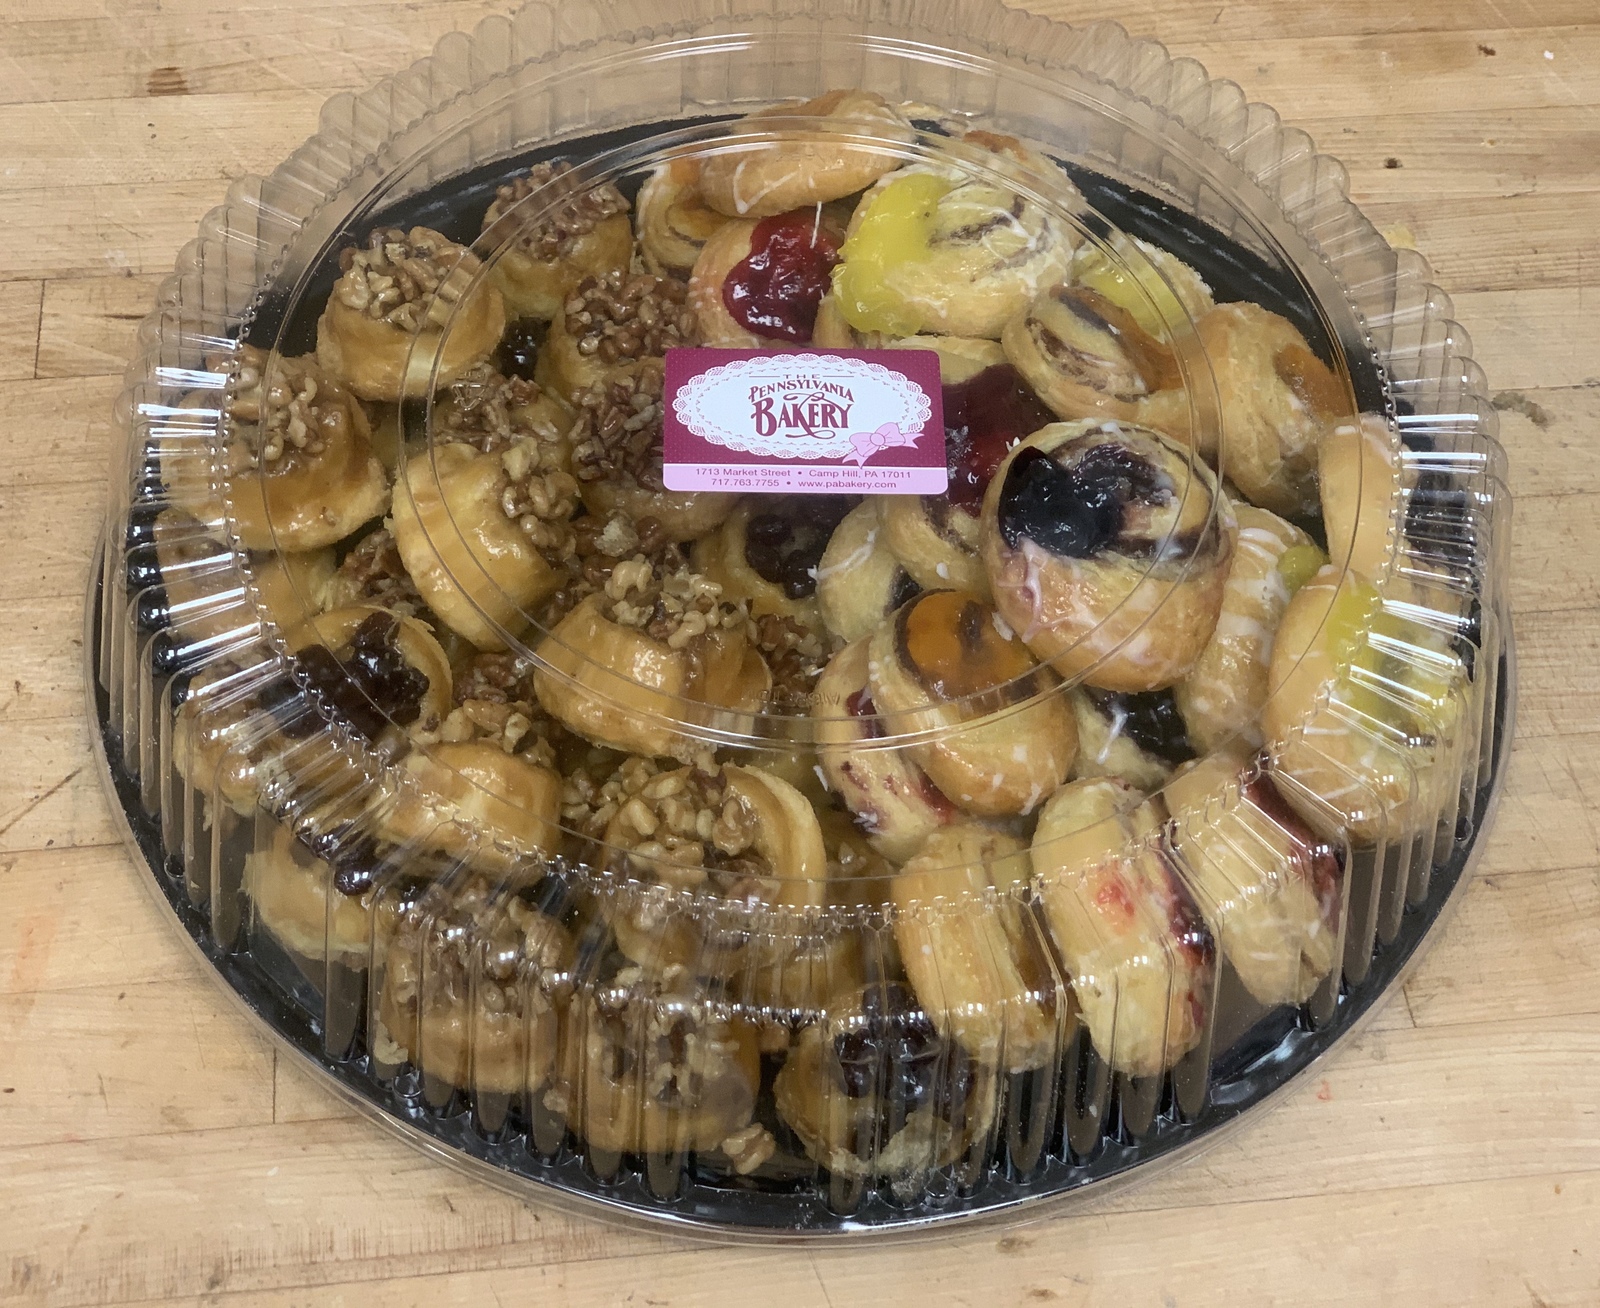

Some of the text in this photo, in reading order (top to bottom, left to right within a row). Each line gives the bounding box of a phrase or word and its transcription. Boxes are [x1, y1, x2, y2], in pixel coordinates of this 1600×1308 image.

[748, 379, 855, 403] PENNSYLVANIA
[750, 392, 854, 439] BAKERY
[696, 468, 720, 476] 1713
[723, 468, 758, 476] Market
[760, 468, 791, 477] Street
[809, 469, 839, 478] Camp
[842, 470, 861, 478] Hill,
[864, 470, 878, 478] PA
[711, 478, 897, 489] 717.763.7755 www.pabakery.com
